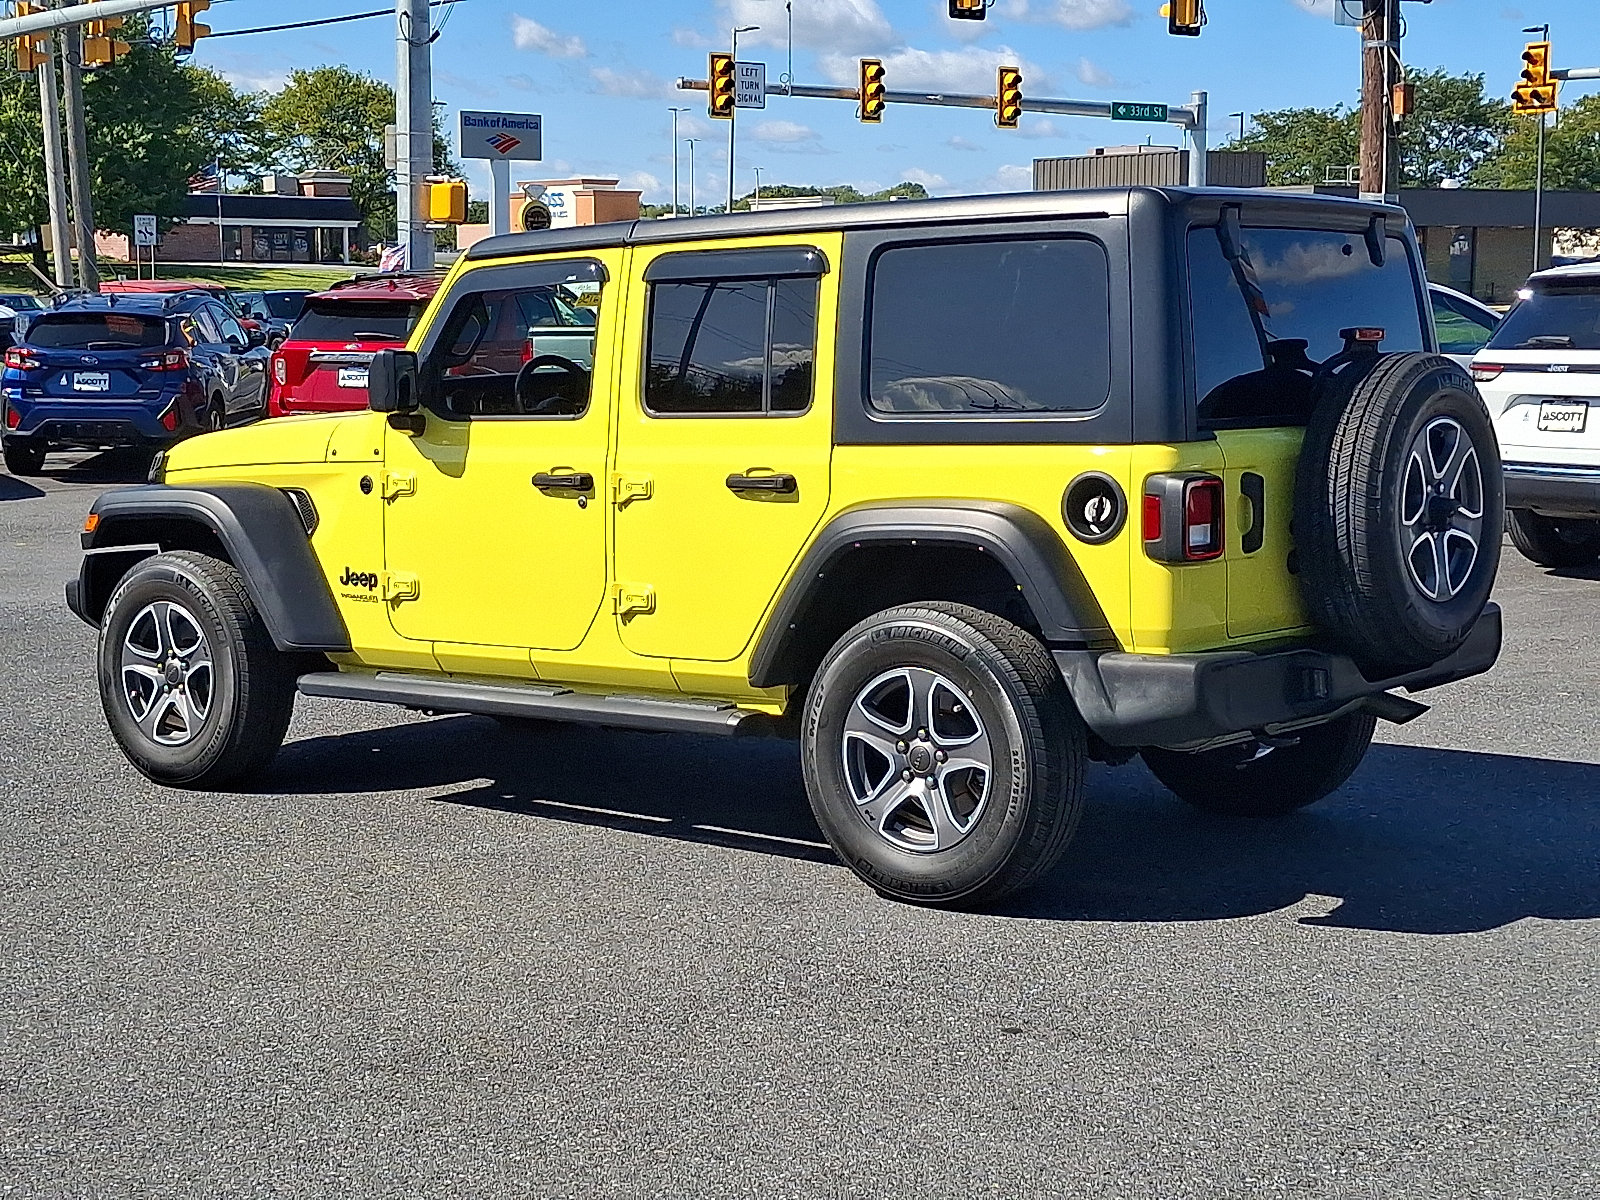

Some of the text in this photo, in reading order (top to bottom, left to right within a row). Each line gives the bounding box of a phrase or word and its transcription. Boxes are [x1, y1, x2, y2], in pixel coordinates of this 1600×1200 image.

[741, 67, 759, 77] LEFT
[741, 80, 760, 90] TURN
[737, 93, 762, 103] SIGNAL
[1130, 105, 1163, 117] 33rd St
[464, 115, 539, 130] Bank of America
[1550, 411, 1583, 421] SCOTT
[339, 566, 378, 591] Jeep
[890, 626, 970, 660] MICHELIN
